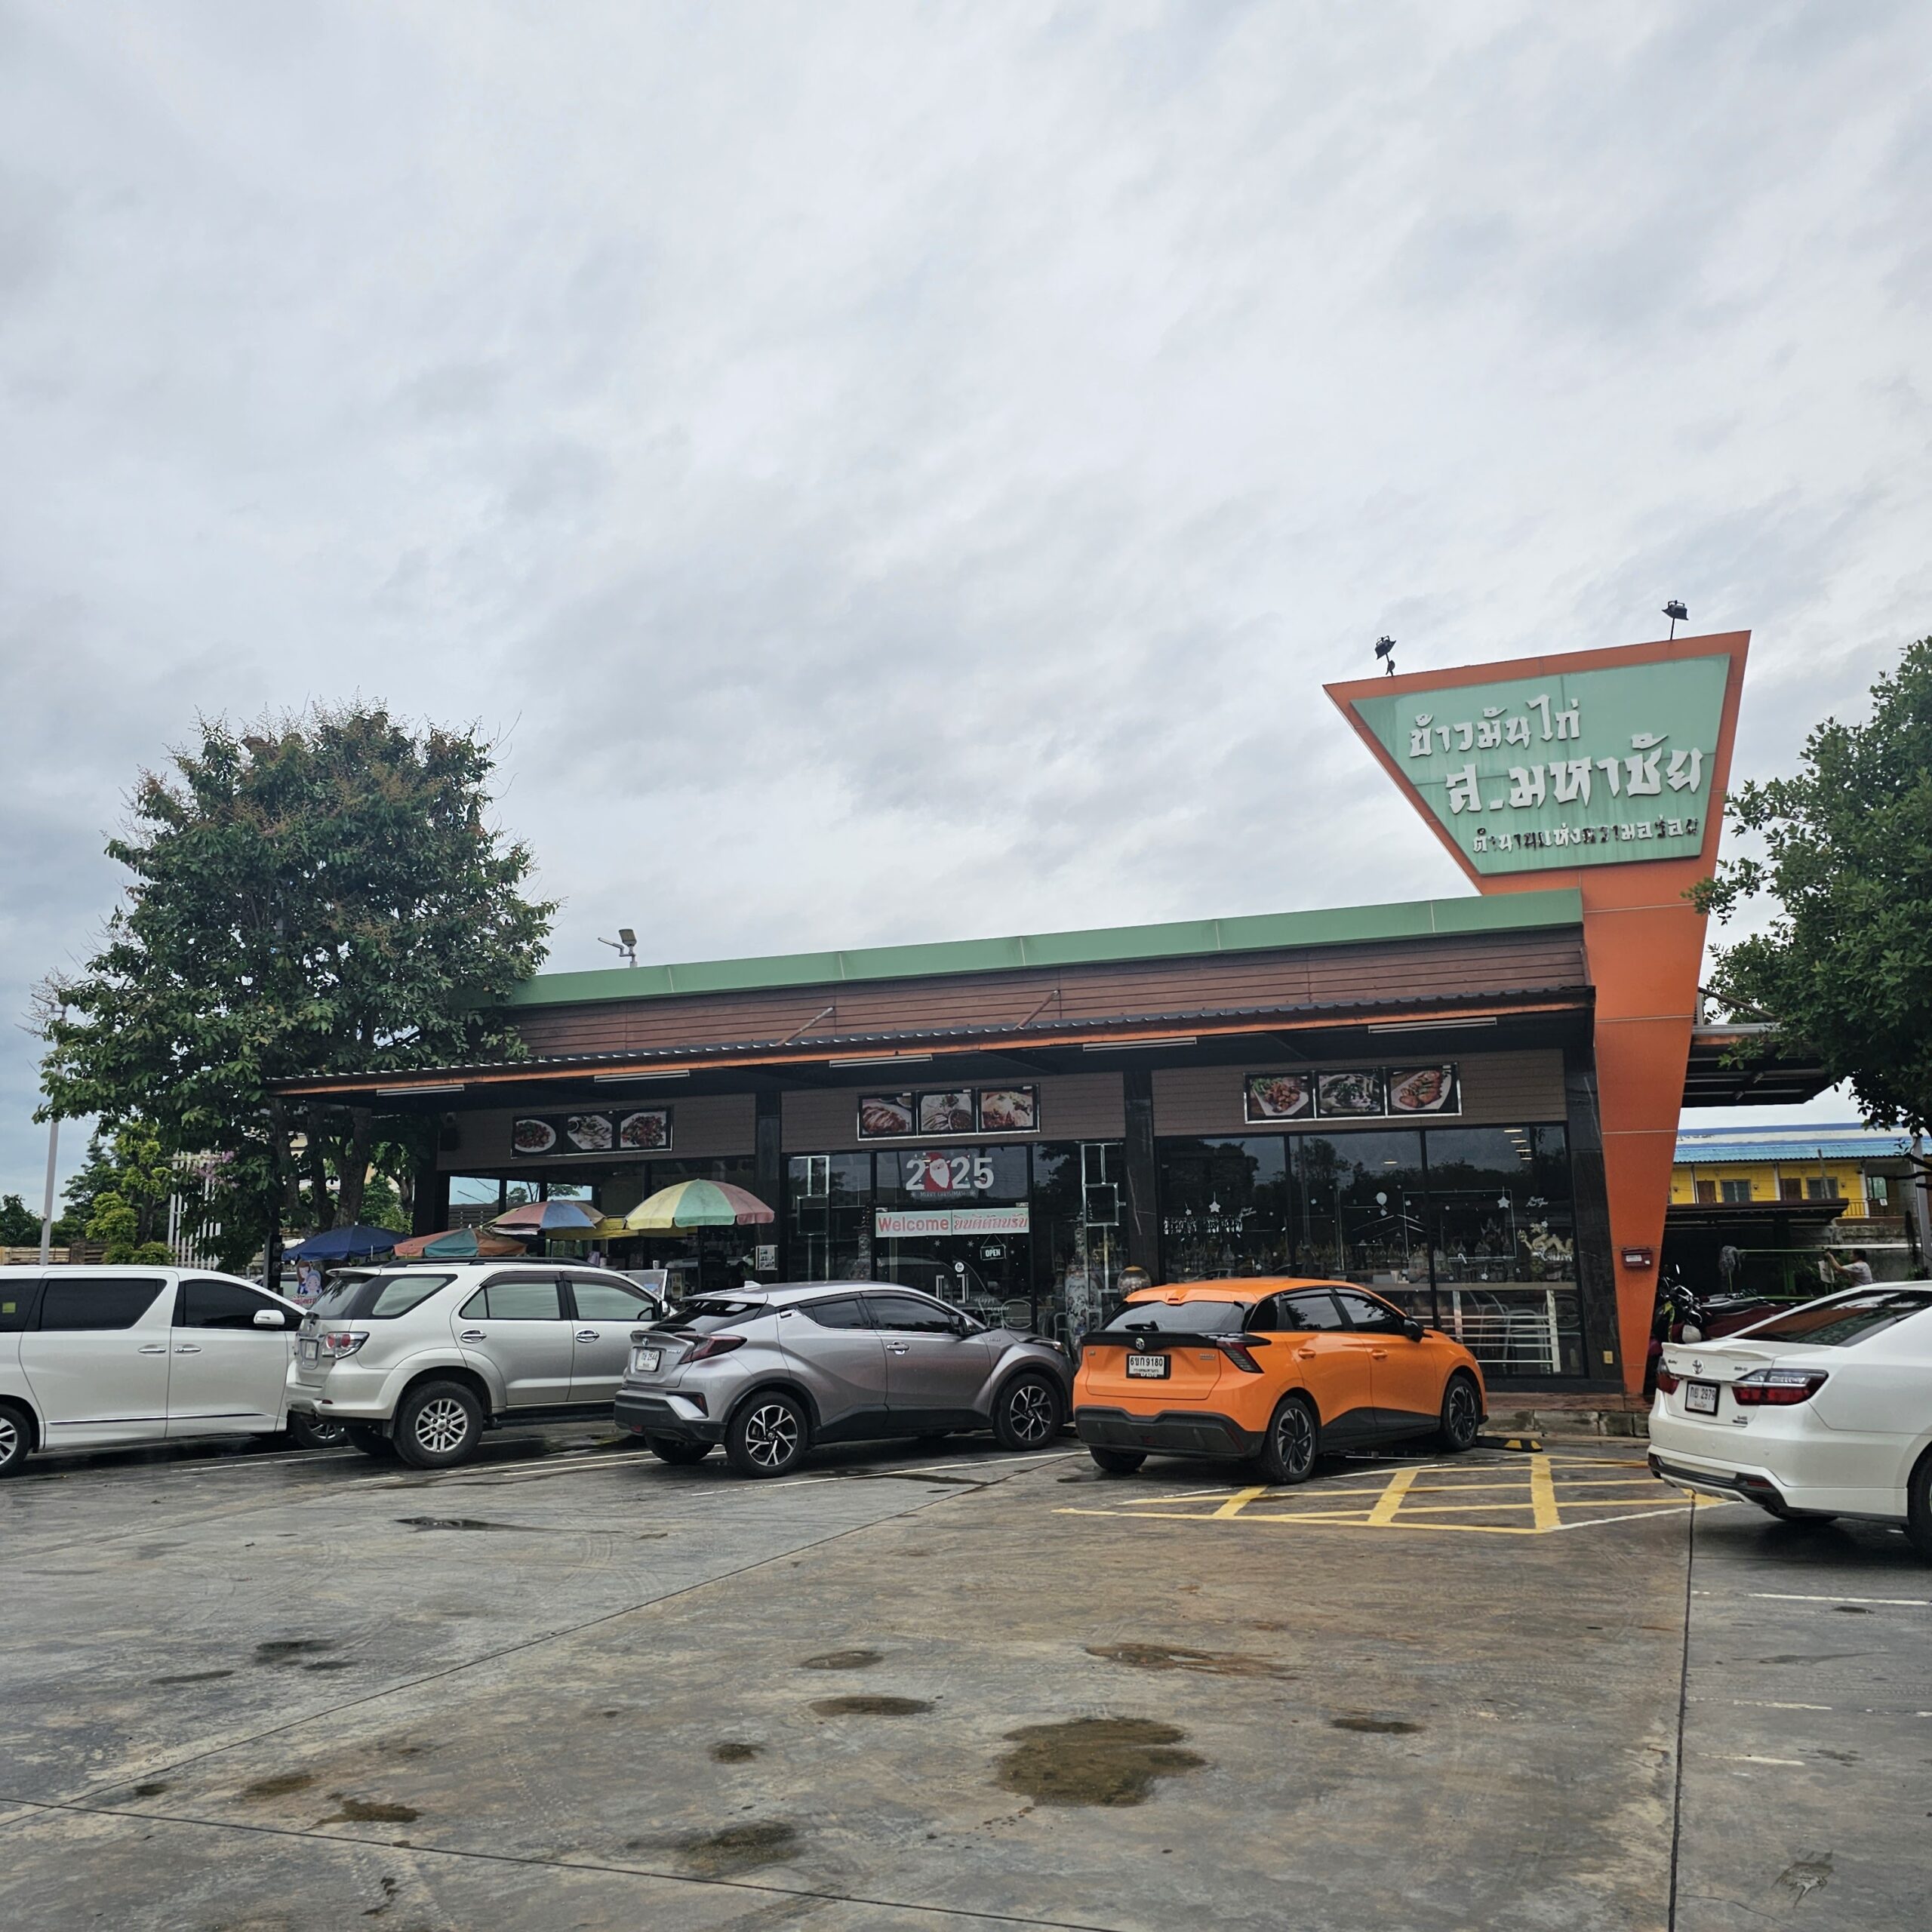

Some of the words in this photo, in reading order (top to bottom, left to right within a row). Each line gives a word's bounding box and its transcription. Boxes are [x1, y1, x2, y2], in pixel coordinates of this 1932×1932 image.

[1409, 694, 1580, 758] ข้าวมันไก่
[1445, 733, 1703, 814] ส.มหาชัย
[878, 1216, 949, 1232] Welcome
[985, 1248, 1001, 1257] OPEN
[1146, 1358, 1163, 1367] 9180
